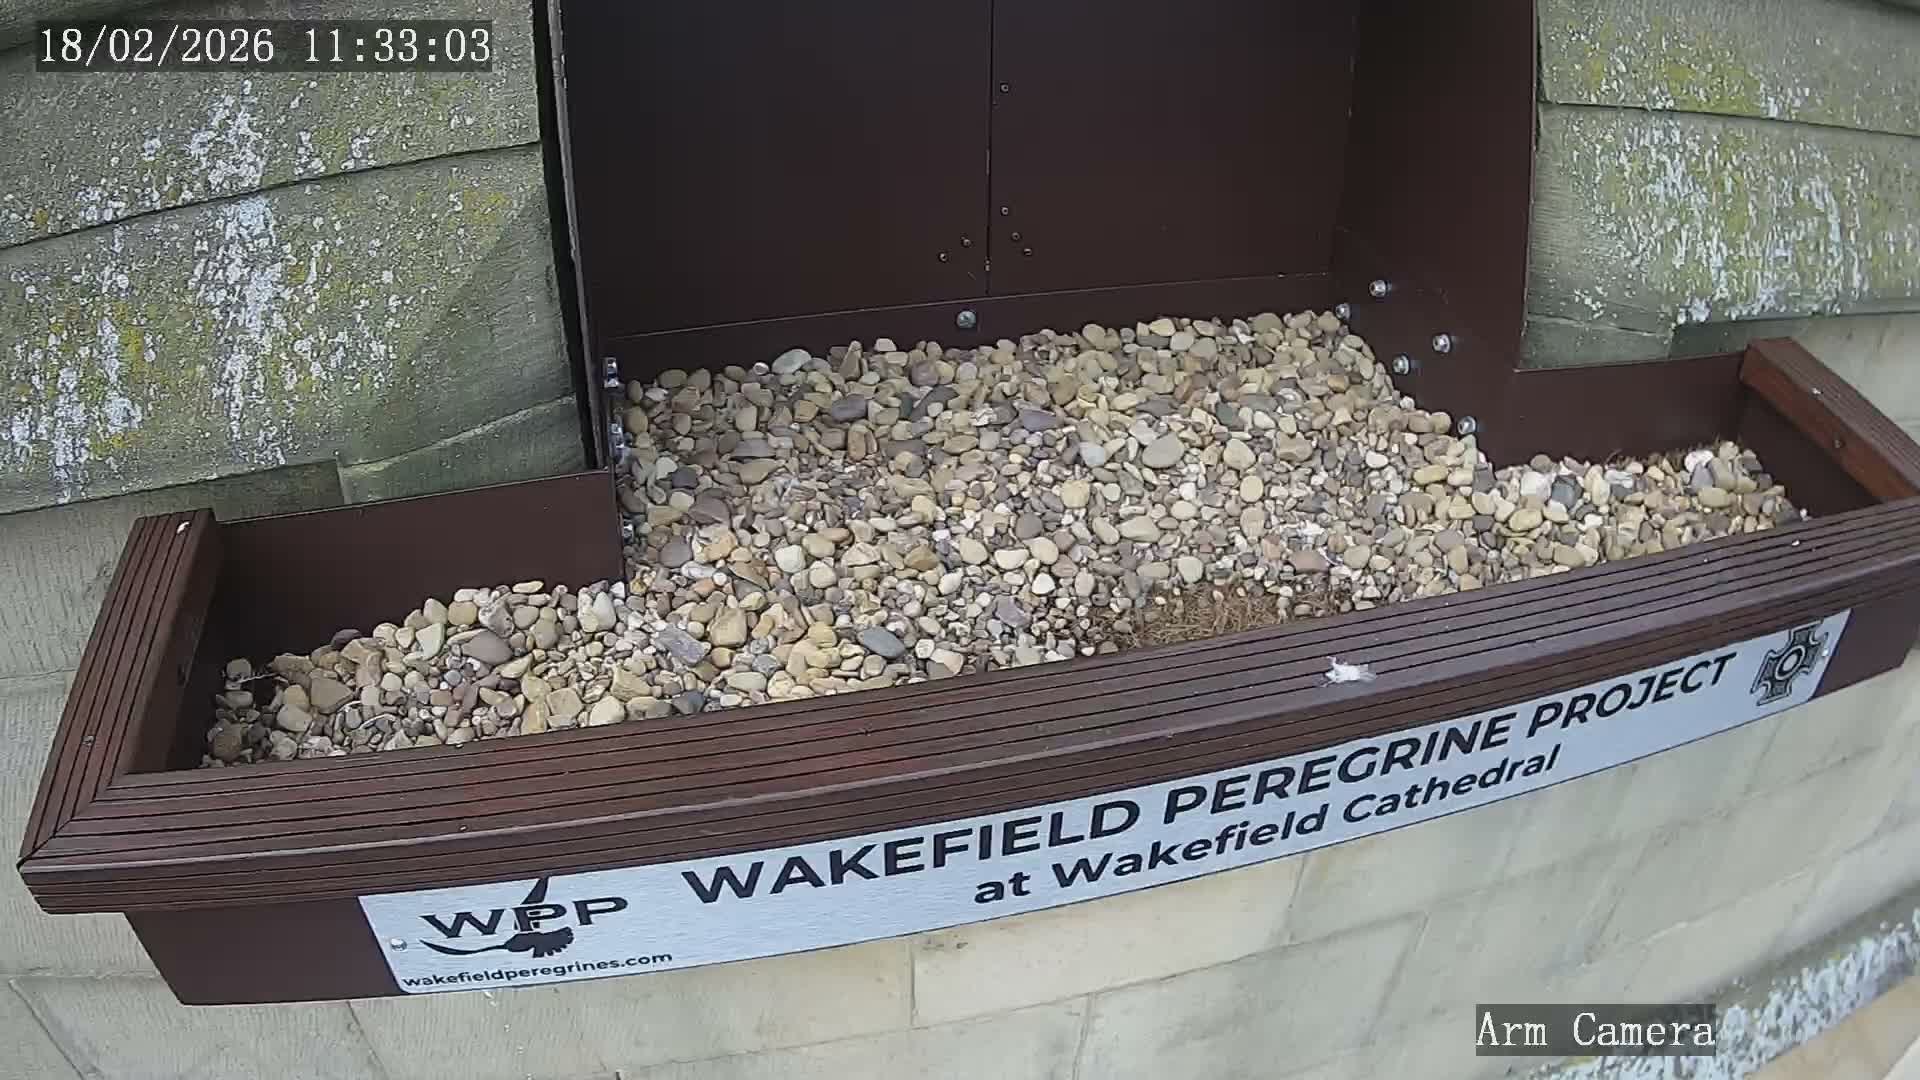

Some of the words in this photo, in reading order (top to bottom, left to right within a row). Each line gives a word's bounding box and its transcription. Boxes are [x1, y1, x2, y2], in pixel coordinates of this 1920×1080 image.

[682, 800, 1140, 904] WAKEFIELD
[1164, 713, 1517, 825] PEREGRINE
[1527, 652, 1737, 738] PROJECT
[974, 874, 1031, 904] at
[1052, 804, 1331, 888] Wakefield
[1343, 744, 1561, 824] Cathedral
[419, 896, 629, 939] WPP
[402, 951, 673, 987] wakefieldperegrines.com
